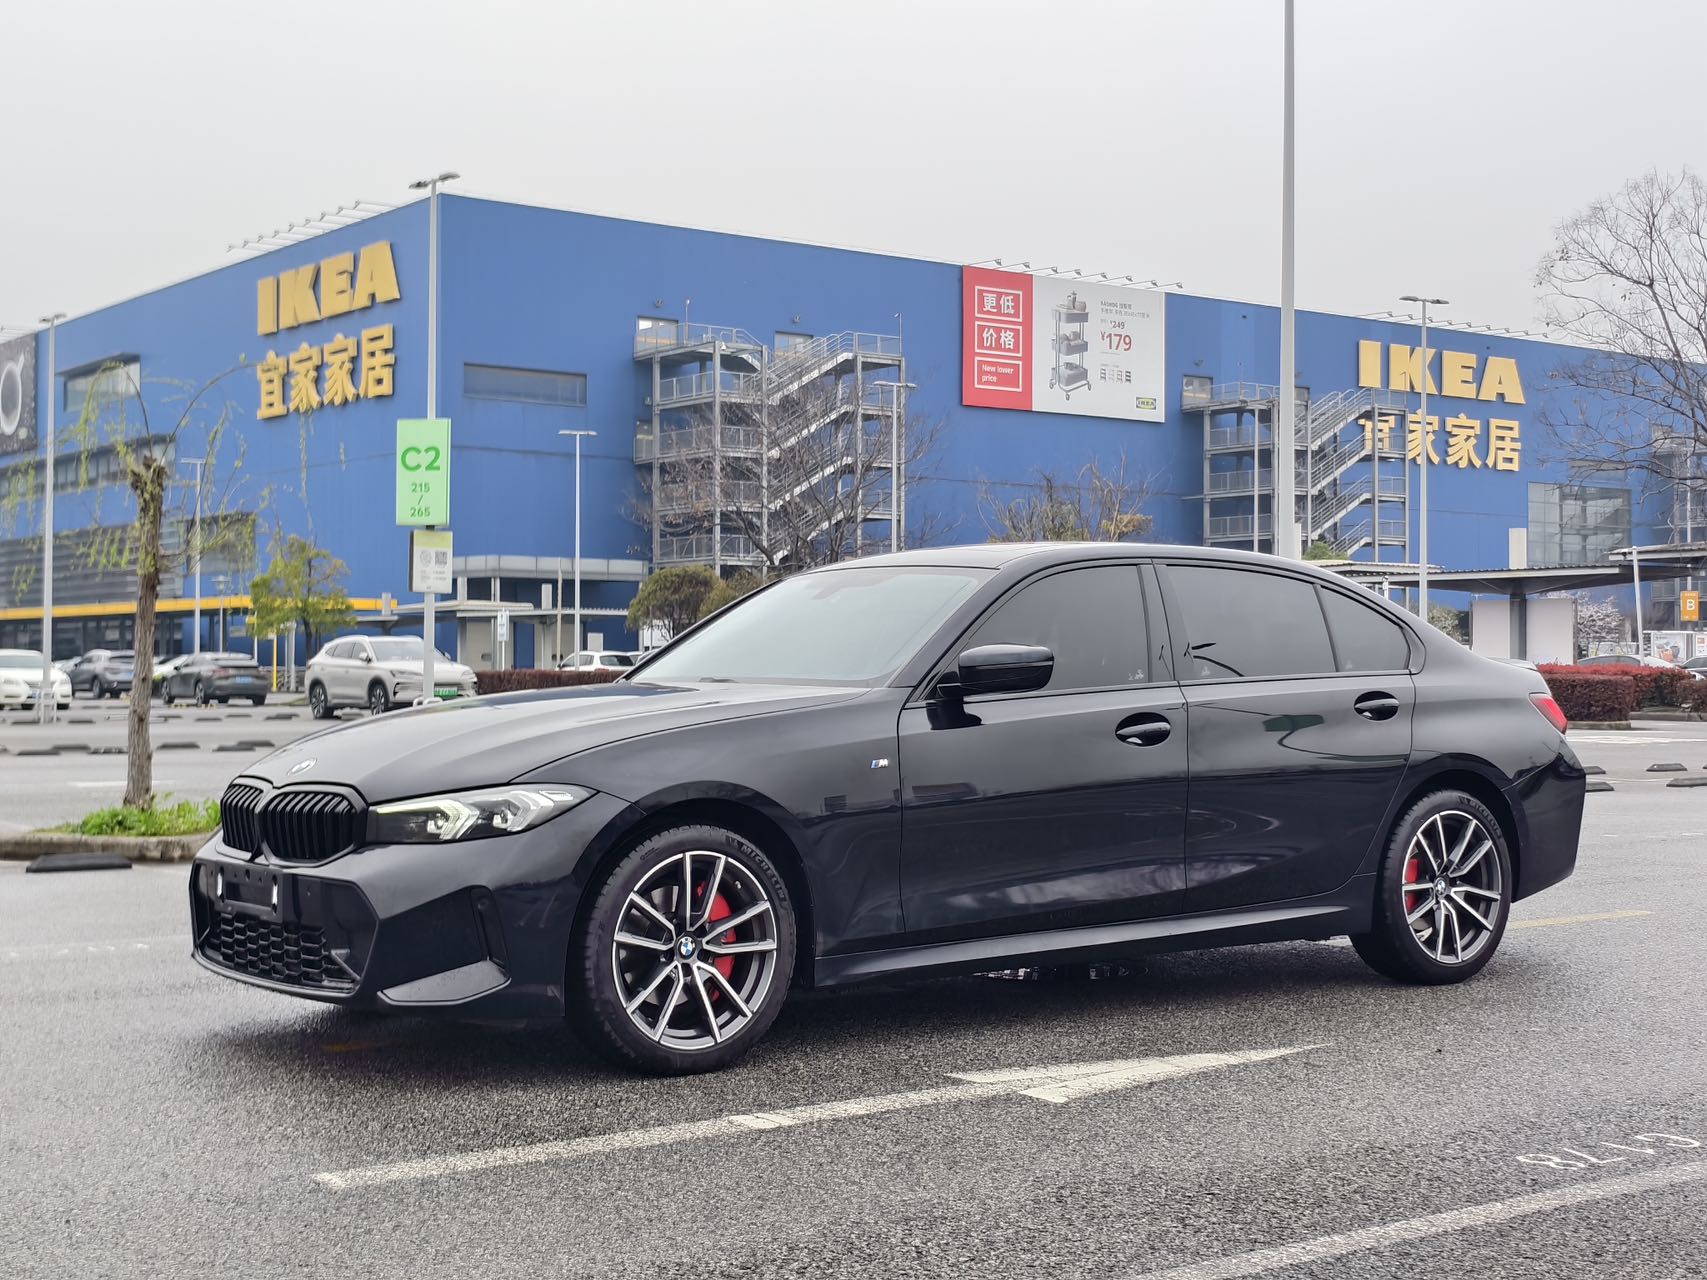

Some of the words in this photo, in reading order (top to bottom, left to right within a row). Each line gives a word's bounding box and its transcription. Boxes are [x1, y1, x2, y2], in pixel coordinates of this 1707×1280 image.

[257, 239, 401, 336] IKEA
[982, 293, 1015, 315] 更低
[982, 327, 1015, 350] 价格
[1100, 331, 1132, 352] ¥179
[256, 323, 396, 420] 宜家家居
[981, 374, 997, 384] price
[982, 364, 996, 373] New
[996, 365, 1014, 374] lower
[1358, 339, 1527, 405] IKEA
[400, 446, 441, 472] C2
[411, 482, 430, 494] 215
[410, 506, 431, 518] 265
[1686, 599, 1695, 611] B
[740, 844, 786, 900] MICHELIN
